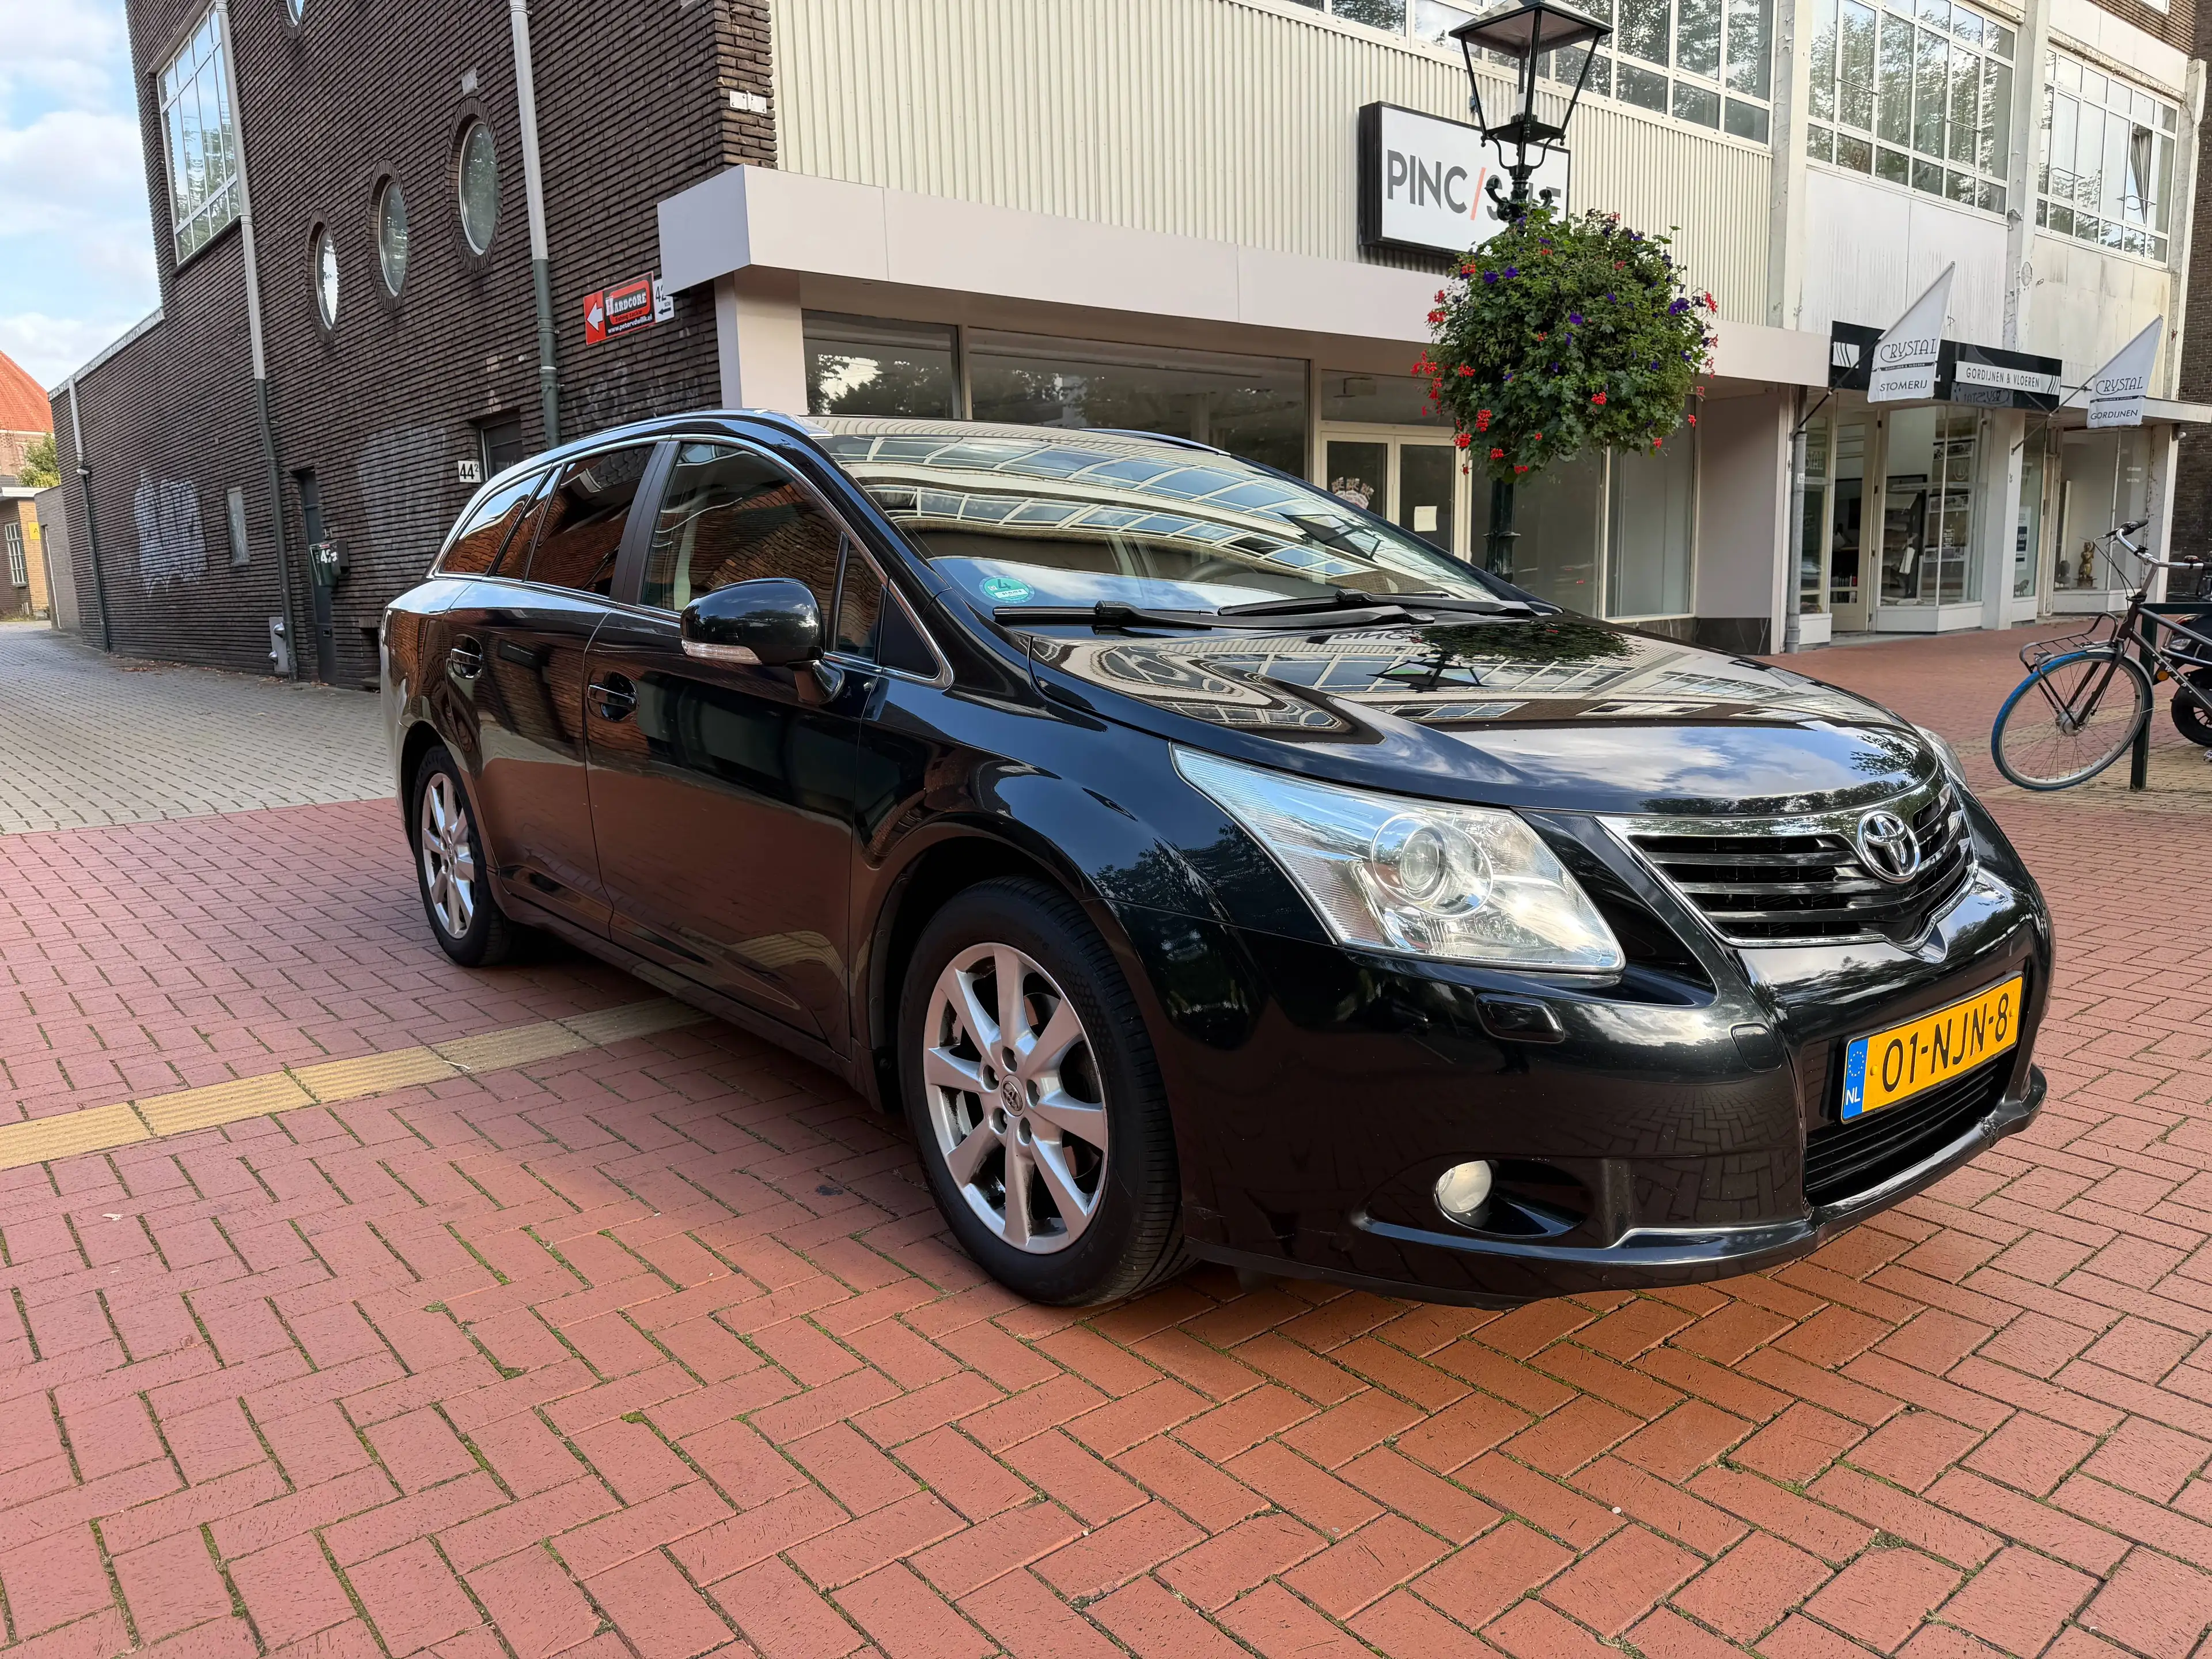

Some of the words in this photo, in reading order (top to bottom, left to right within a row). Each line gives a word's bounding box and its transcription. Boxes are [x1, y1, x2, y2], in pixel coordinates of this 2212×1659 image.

[605, 291, 647, 316] HARDCORE
[1880, 338, 1937, 362] CRYSTAL
[1880, 380, 1927, 392] STOMERIJ
[1966, 367, 2004, 383] GORDIJNEN
[2006, 373, 2010, 384] &
[2013, 374, 2040, 388] VLOEREN
[2096, 376, 2143, 396] CRYSTAL
[2090, 409, 2138, 420] GORDIJNEN
[1881, 992, 2009, 1093] 01-NJN-8
[1846, 1087, 1861, 1106] NL
